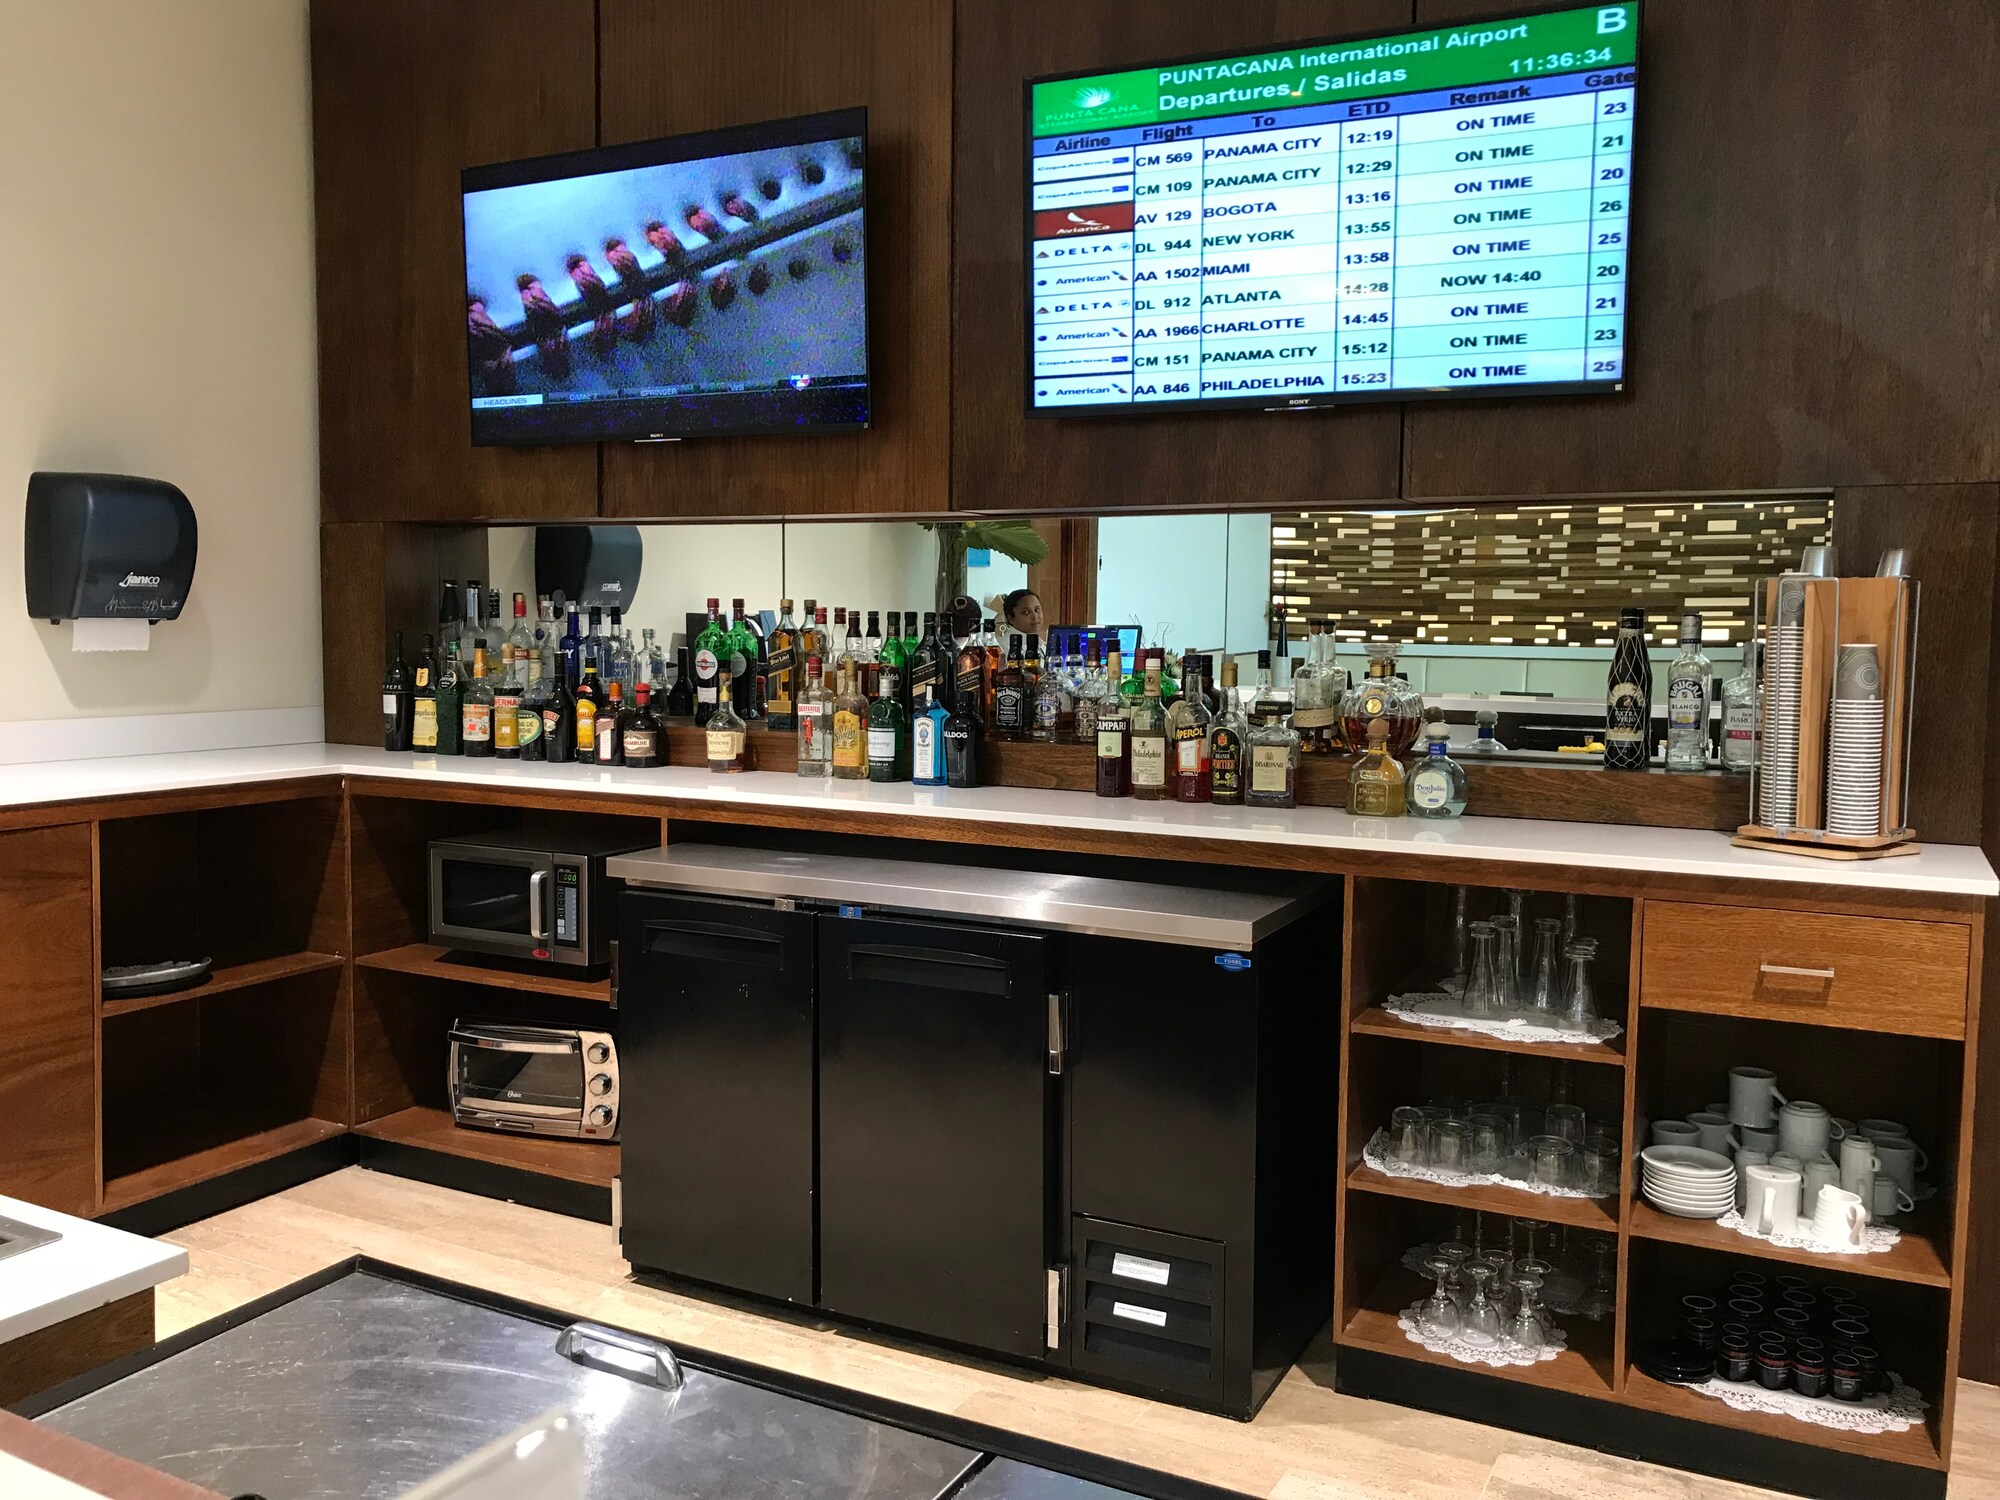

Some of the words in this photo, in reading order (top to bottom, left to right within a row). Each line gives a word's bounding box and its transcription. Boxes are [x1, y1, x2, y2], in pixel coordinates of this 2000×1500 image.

[1597, 7, 1627, 34] B
[1158, 56, 1294, 86] PUNTACANA
[1300, 36, 1439, 68] International
[1446, 24, 1528, 49] Airport
[1509, 47, 1613, 74] 11:36:34
[1159, 83, 1290, 112] Departures
[1314, 66, 1407, 92] Salidas
[1045, 110, 1093, 122] PUNTA
[1099, 104, 1139, 116] CANA
[1055, 135, 1110, 152] Airline
[1142, 124, 1193, 143] Flight
[1252, 115, 1276, 128] To
[1348, 101, 1390, 117] ETD
[1450, 85, 1532, 106] Remark
[1584, 71, 1635, 88] Gate
[1135, 155, 1160, 167] CM
[1166, 152, 1193, 164] 569
[1204, 143, 1278, 160] PANAMA
[1283, 138, 1322, 151] CITY
[1346, 129, 1393, 144] 12:19
[1456, 118, 1484, 132] ON
[1490, 113, 1535, 127] TIME
[1603, 102, 1627, 115] 23
[1135, 185, 1160, 197] CM
[1166, 181, 1193, 193] 109
[1203, 172, 1278, 189] PANAMA
[1282, 167, 1321, 180] CITY
[1346, 160, 1392, 175] 12:29
[1455, 150, 1483, 163] ON
[1489, 145, 1535, 159] TIME
[1602, 135, 1624, 148] 21
[1135, 213, 1158, 226] AV
[1165, 210, 1192, 222] 129
[1203, 202, 1277, 219] BOGOTA
[1345, 191, 1391, 205] 13:16
[1454, 181, 1482, 194] ON
[1488, 176, 1533, 190] TIME
[1600, 167, 1624, 181] 20
[1054, 244, 1113, 257] DELTA
[1134, 242, 1156, 254] DL
[1164, 239, 1192, 251] 944
[1202, 235, 1242, 248] NEW
[1246, 229, 1295, 243] YORK
[1344, 221, 1391, 235] 13:55
[1453, 213, 1481, 225] ON
[1487, 208, 1532, 222] TIME
[1599, 200, 1622, 213] 26
[1055, 273, 1110, 285] American
[1134, 271, 1158, 282] AA
[1164, 267, 1201, 280] 1502
[1202, 263, 1250, 277] MIAMI
[1344, 252, 1390, 265] 13:58
[1452, 244, 1480, 256] ON
[1486, 239, 1531, 253] TIME
[1597, 232, 1622, 245] 25
[1054, 301, 1113, 313] DELTA
[1134, 300, 1156, 311] DL
[1163, 297, 1191, 308] 912
[1201, 290, 1281, 306] ATLANTA
[1343, 282, 1389, 295] 14:28
[1441, 274, 1487, 288] NOW
[1492, 270, 1542, 284] 14:40
[1596, 265, 1620, 277] 20
[1055, 330, 1110, 341] American
[1134, 328, 1157, 339] AA
[1164, 325, 1200, 337] 1966
[1201, 318, 1305, 335] CHARLOTTE
[1342, 312, 1389, 325] 14:45
[1450, 306, 1479, 318] ON
[1484, 303, 1529, 315] TIME
[1595, 297, 1617, 309] 21
[1134, 356, 1159, 368] CM
[1164, 354, 1190, 365] 151
[1201, 350, 1275, 364] PANAMA
[1278, 346, 1318, 359] CITY
[1341, 343, 1388, 355] 15:12
[1449, 337, 1477, 348] ON
[1482, 333, 1528, 346] TIME
[1593, 329, 1617, 341] 23
[1055, 385, 1110, 396] American
[1133, 385, 1157, 395] AA
[1162, 382, 1190, 394] 846
[1201, 376, 1325, 392] PHILADELPHIA
[1341, 373, 1387, 385] 15:23
[1448, 367, 1477, 379] ON
[1481, 364, 1527, 377] TIME
[1592, 361, 1616, 372] 25
[484, 397, 528, 407] HEADLINES
[119, 572, 160, 587] janico
[1670, 681, 1702, 698] BRUGAL
[798, 705, 822, 713] BEEFEATER
[1097, 720, 1126, 731] CAMPARI
[1175, 727, 1204, 740] APEROL
[1132, 748, 1161, 759] Philadelphia
